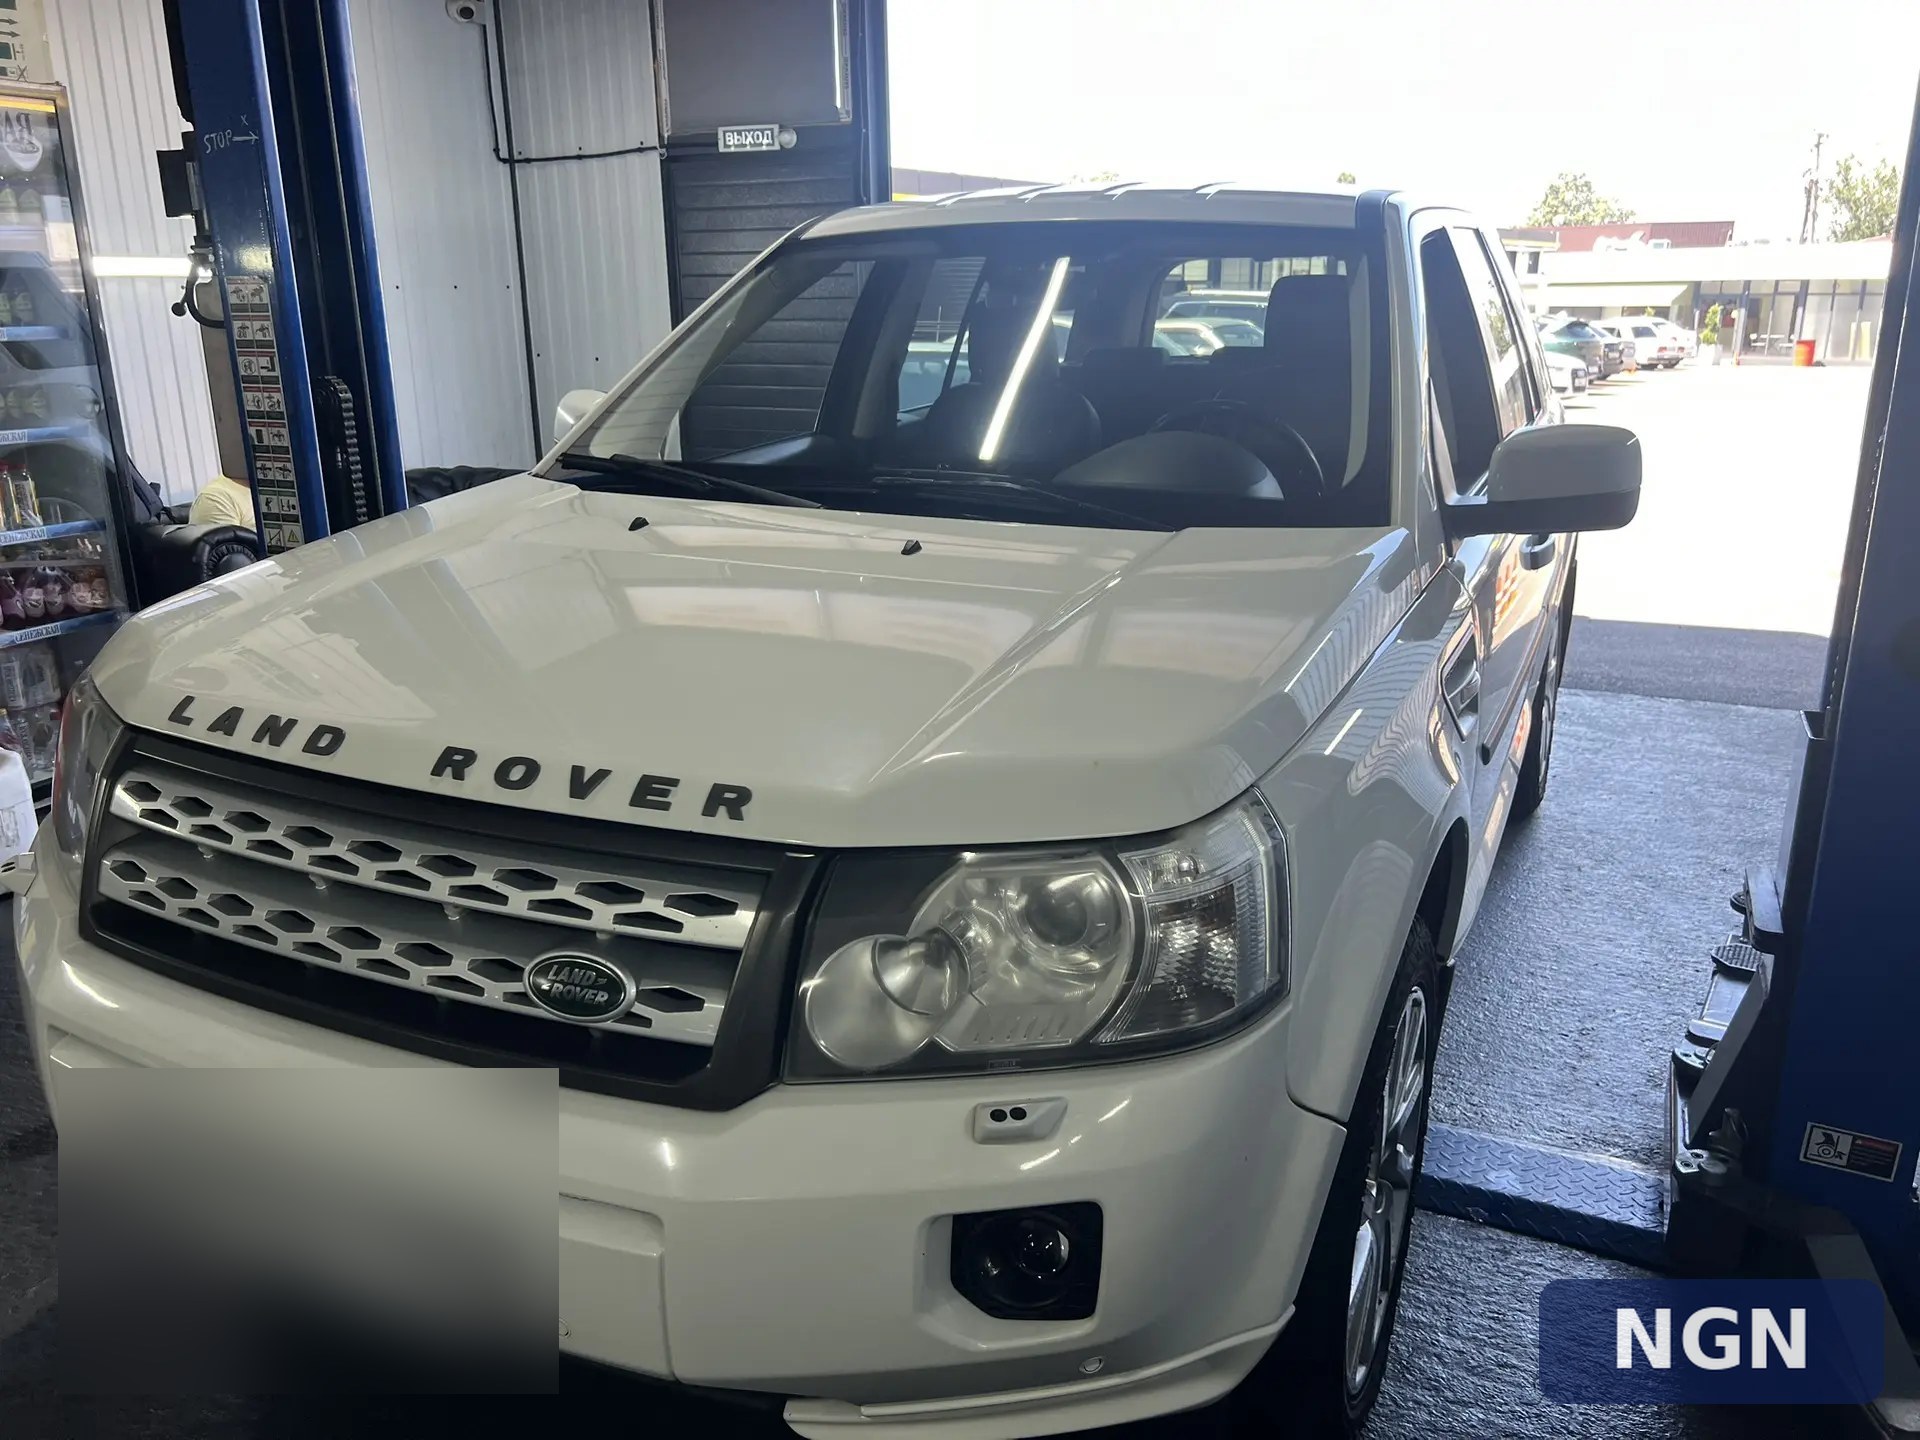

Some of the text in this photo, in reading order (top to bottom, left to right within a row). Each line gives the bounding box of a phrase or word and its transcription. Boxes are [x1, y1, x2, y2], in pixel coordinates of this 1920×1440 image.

[203, 129, 232, 154] STOP
[724, 130, 773, 145] ВЫХОД
[168, 695, 753, 821] LAND ROVER
[547, 964, 597, 986] LAND
[549, 983, 609, 1005] ROVER
